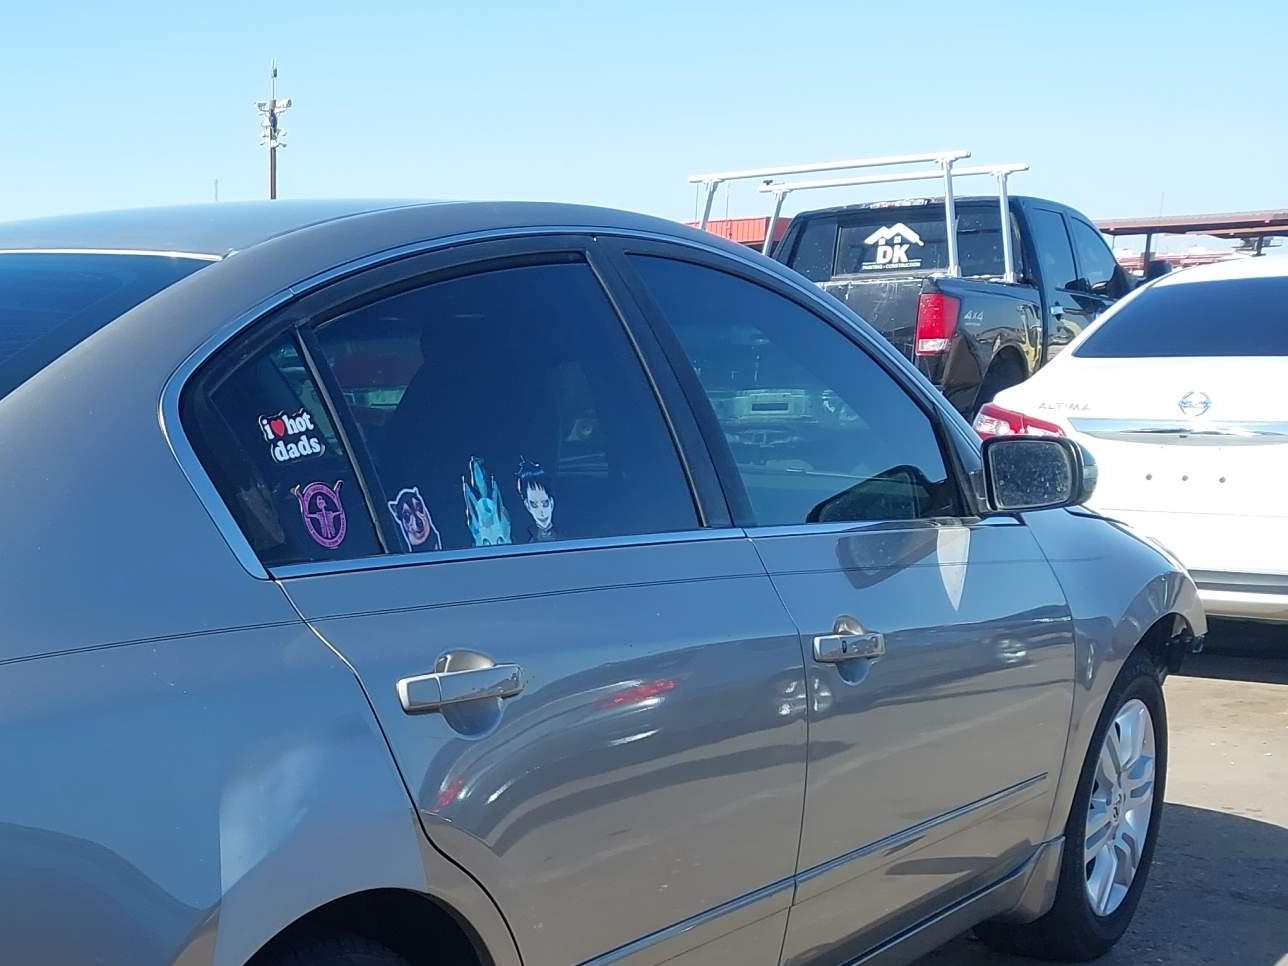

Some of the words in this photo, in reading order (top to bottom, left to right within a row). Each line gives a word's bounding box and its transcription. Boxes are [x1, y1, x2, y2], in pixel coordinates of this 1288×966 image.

[876, 243, 911, 264] DK
[282, 411, 314, 435] hot
[274, 435, 321, 462] dads
